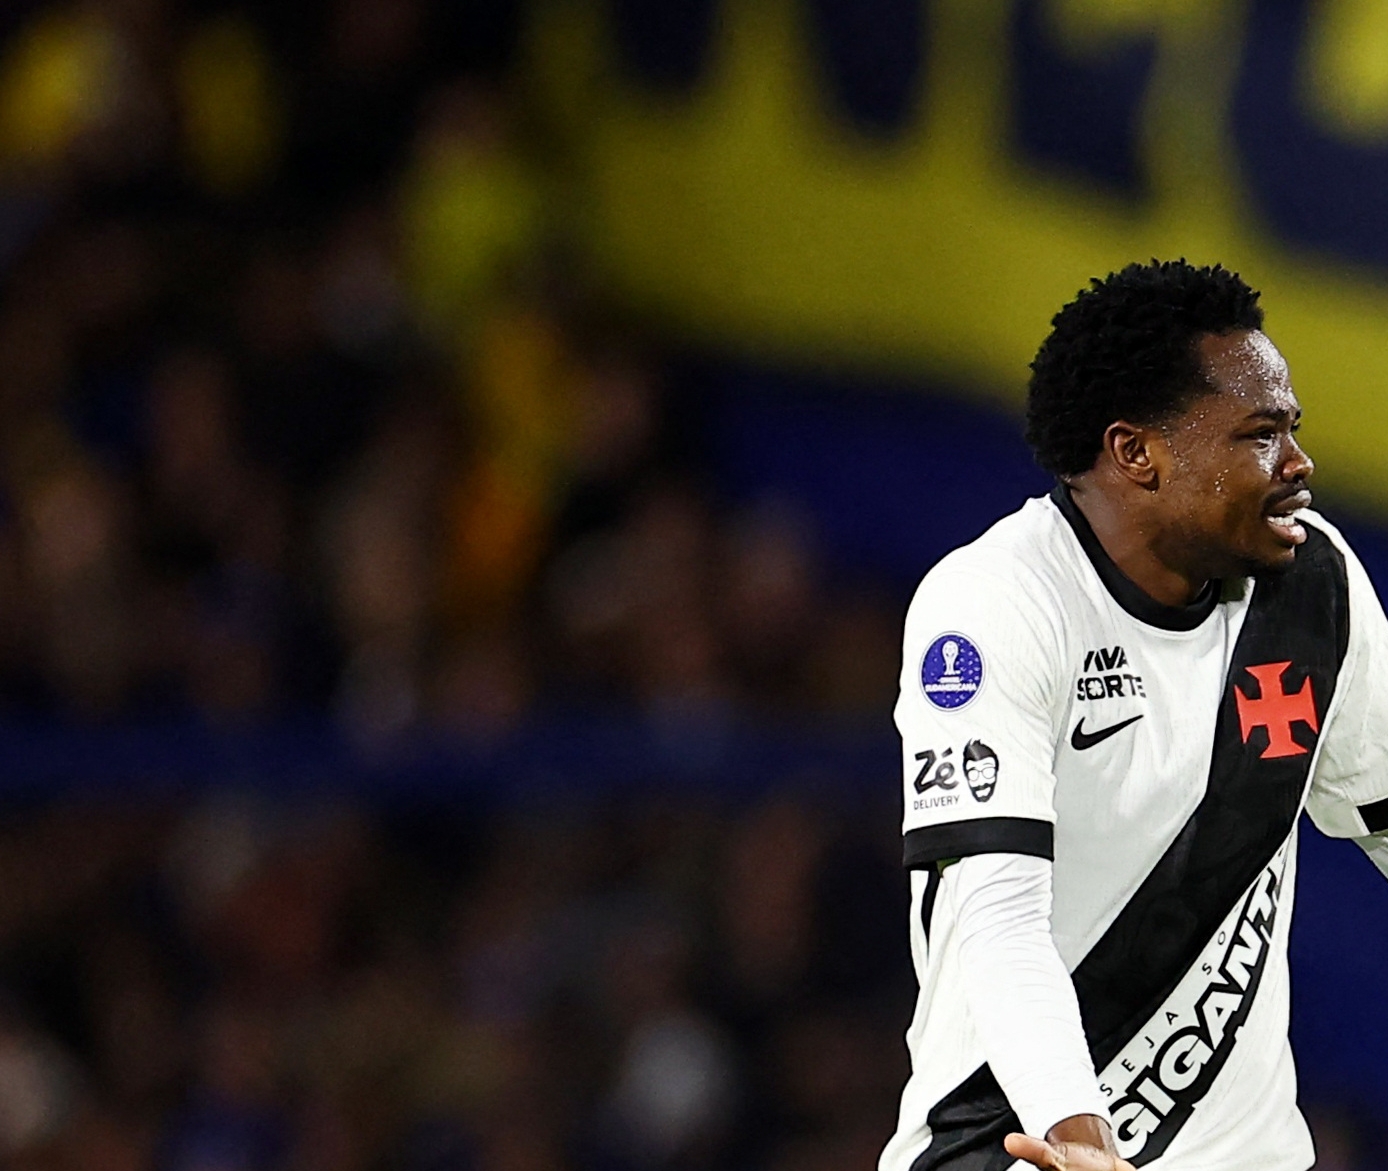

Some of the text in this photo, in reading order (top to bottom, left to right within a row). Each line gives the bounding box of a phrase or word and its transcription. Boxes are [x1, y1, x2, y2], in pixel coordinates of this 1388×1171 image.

[914, 747, 959, 795] Zé
[914, 795, 960, 811] DELIVERY
[1110, 866, 1277, 1160] GIGANT
[1100, 1011, 1178, 1097] SEJA
